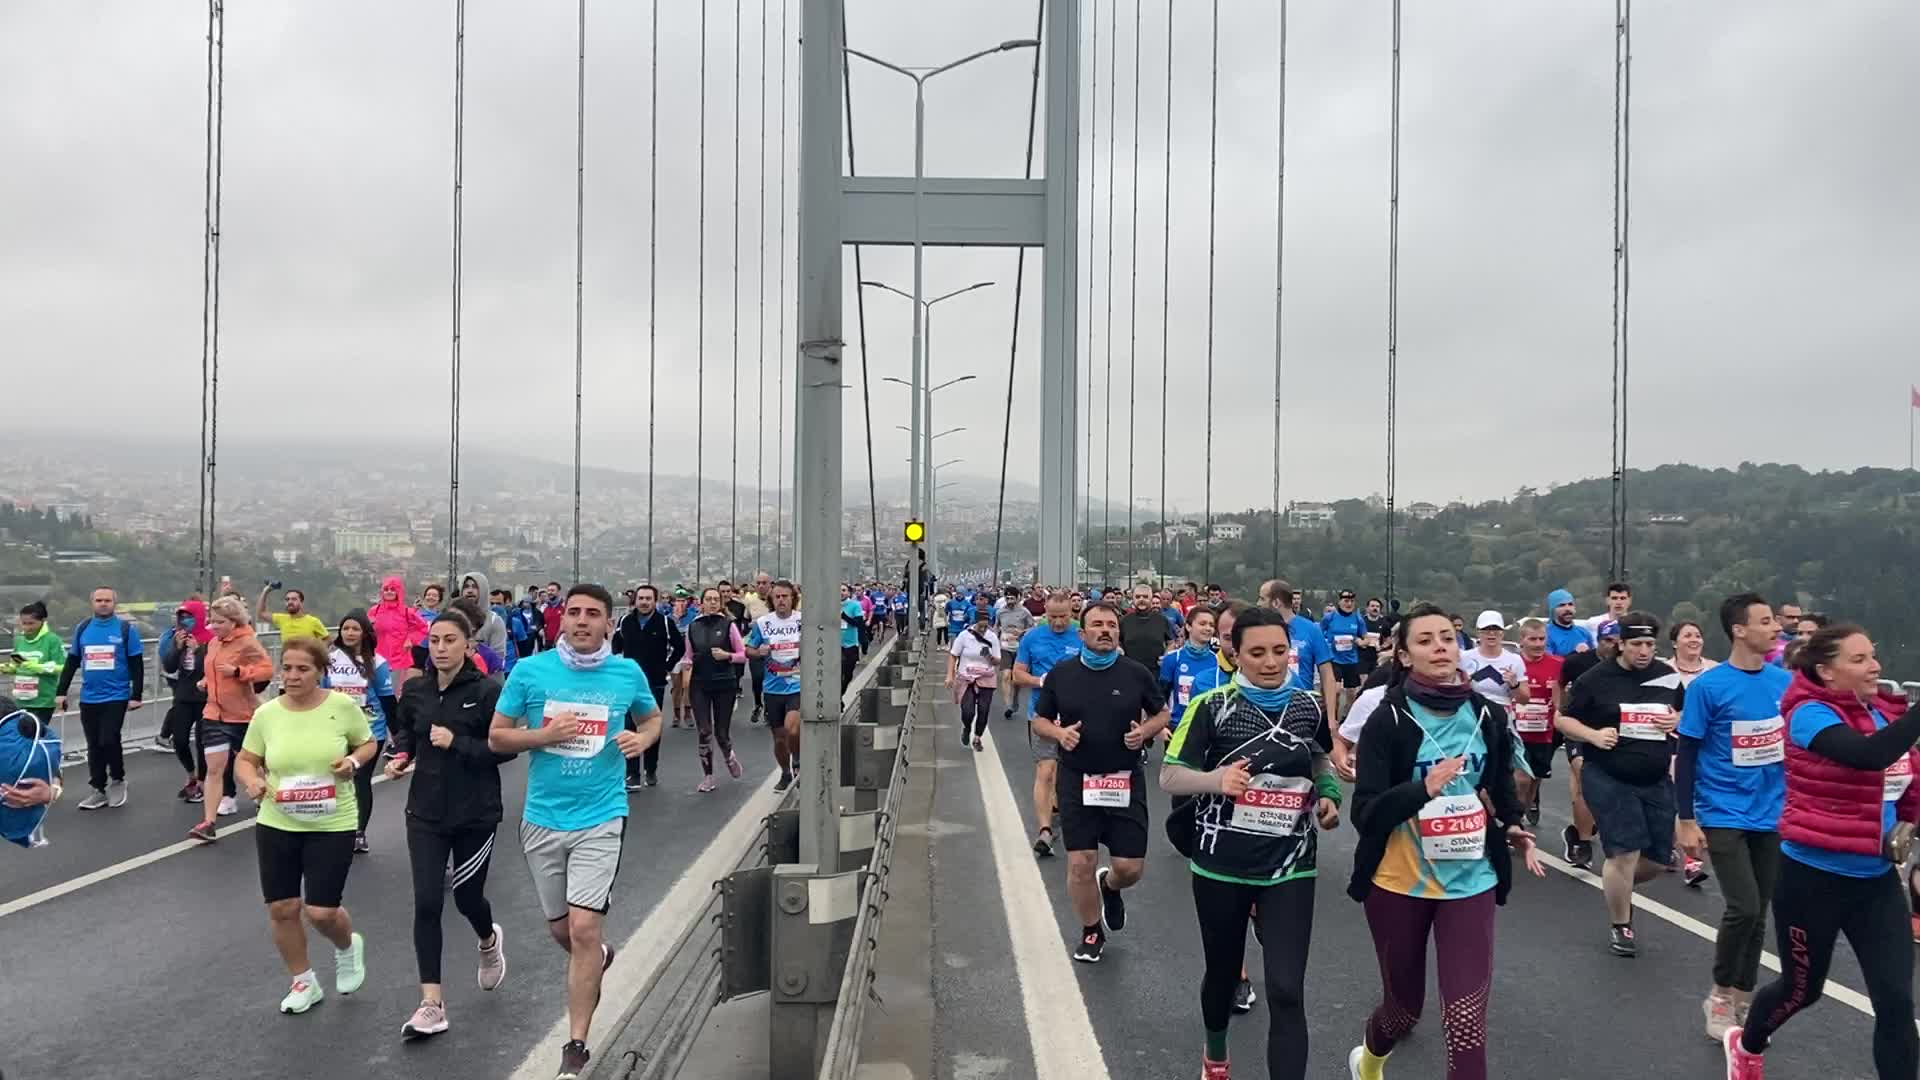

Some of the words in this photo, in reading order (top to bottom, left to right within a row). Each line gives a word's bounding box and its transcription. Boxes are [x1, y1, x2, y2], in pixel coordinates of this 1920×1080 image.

[1738, 736, 1749, 746] G
[282, 790, 290, 801] E
[294, 789, 329, 801] 17028
[1244, 790, 1257, 803] G
[1260, 792, 1302, 808] 22338
[1430, 819, 1445, 833] G
